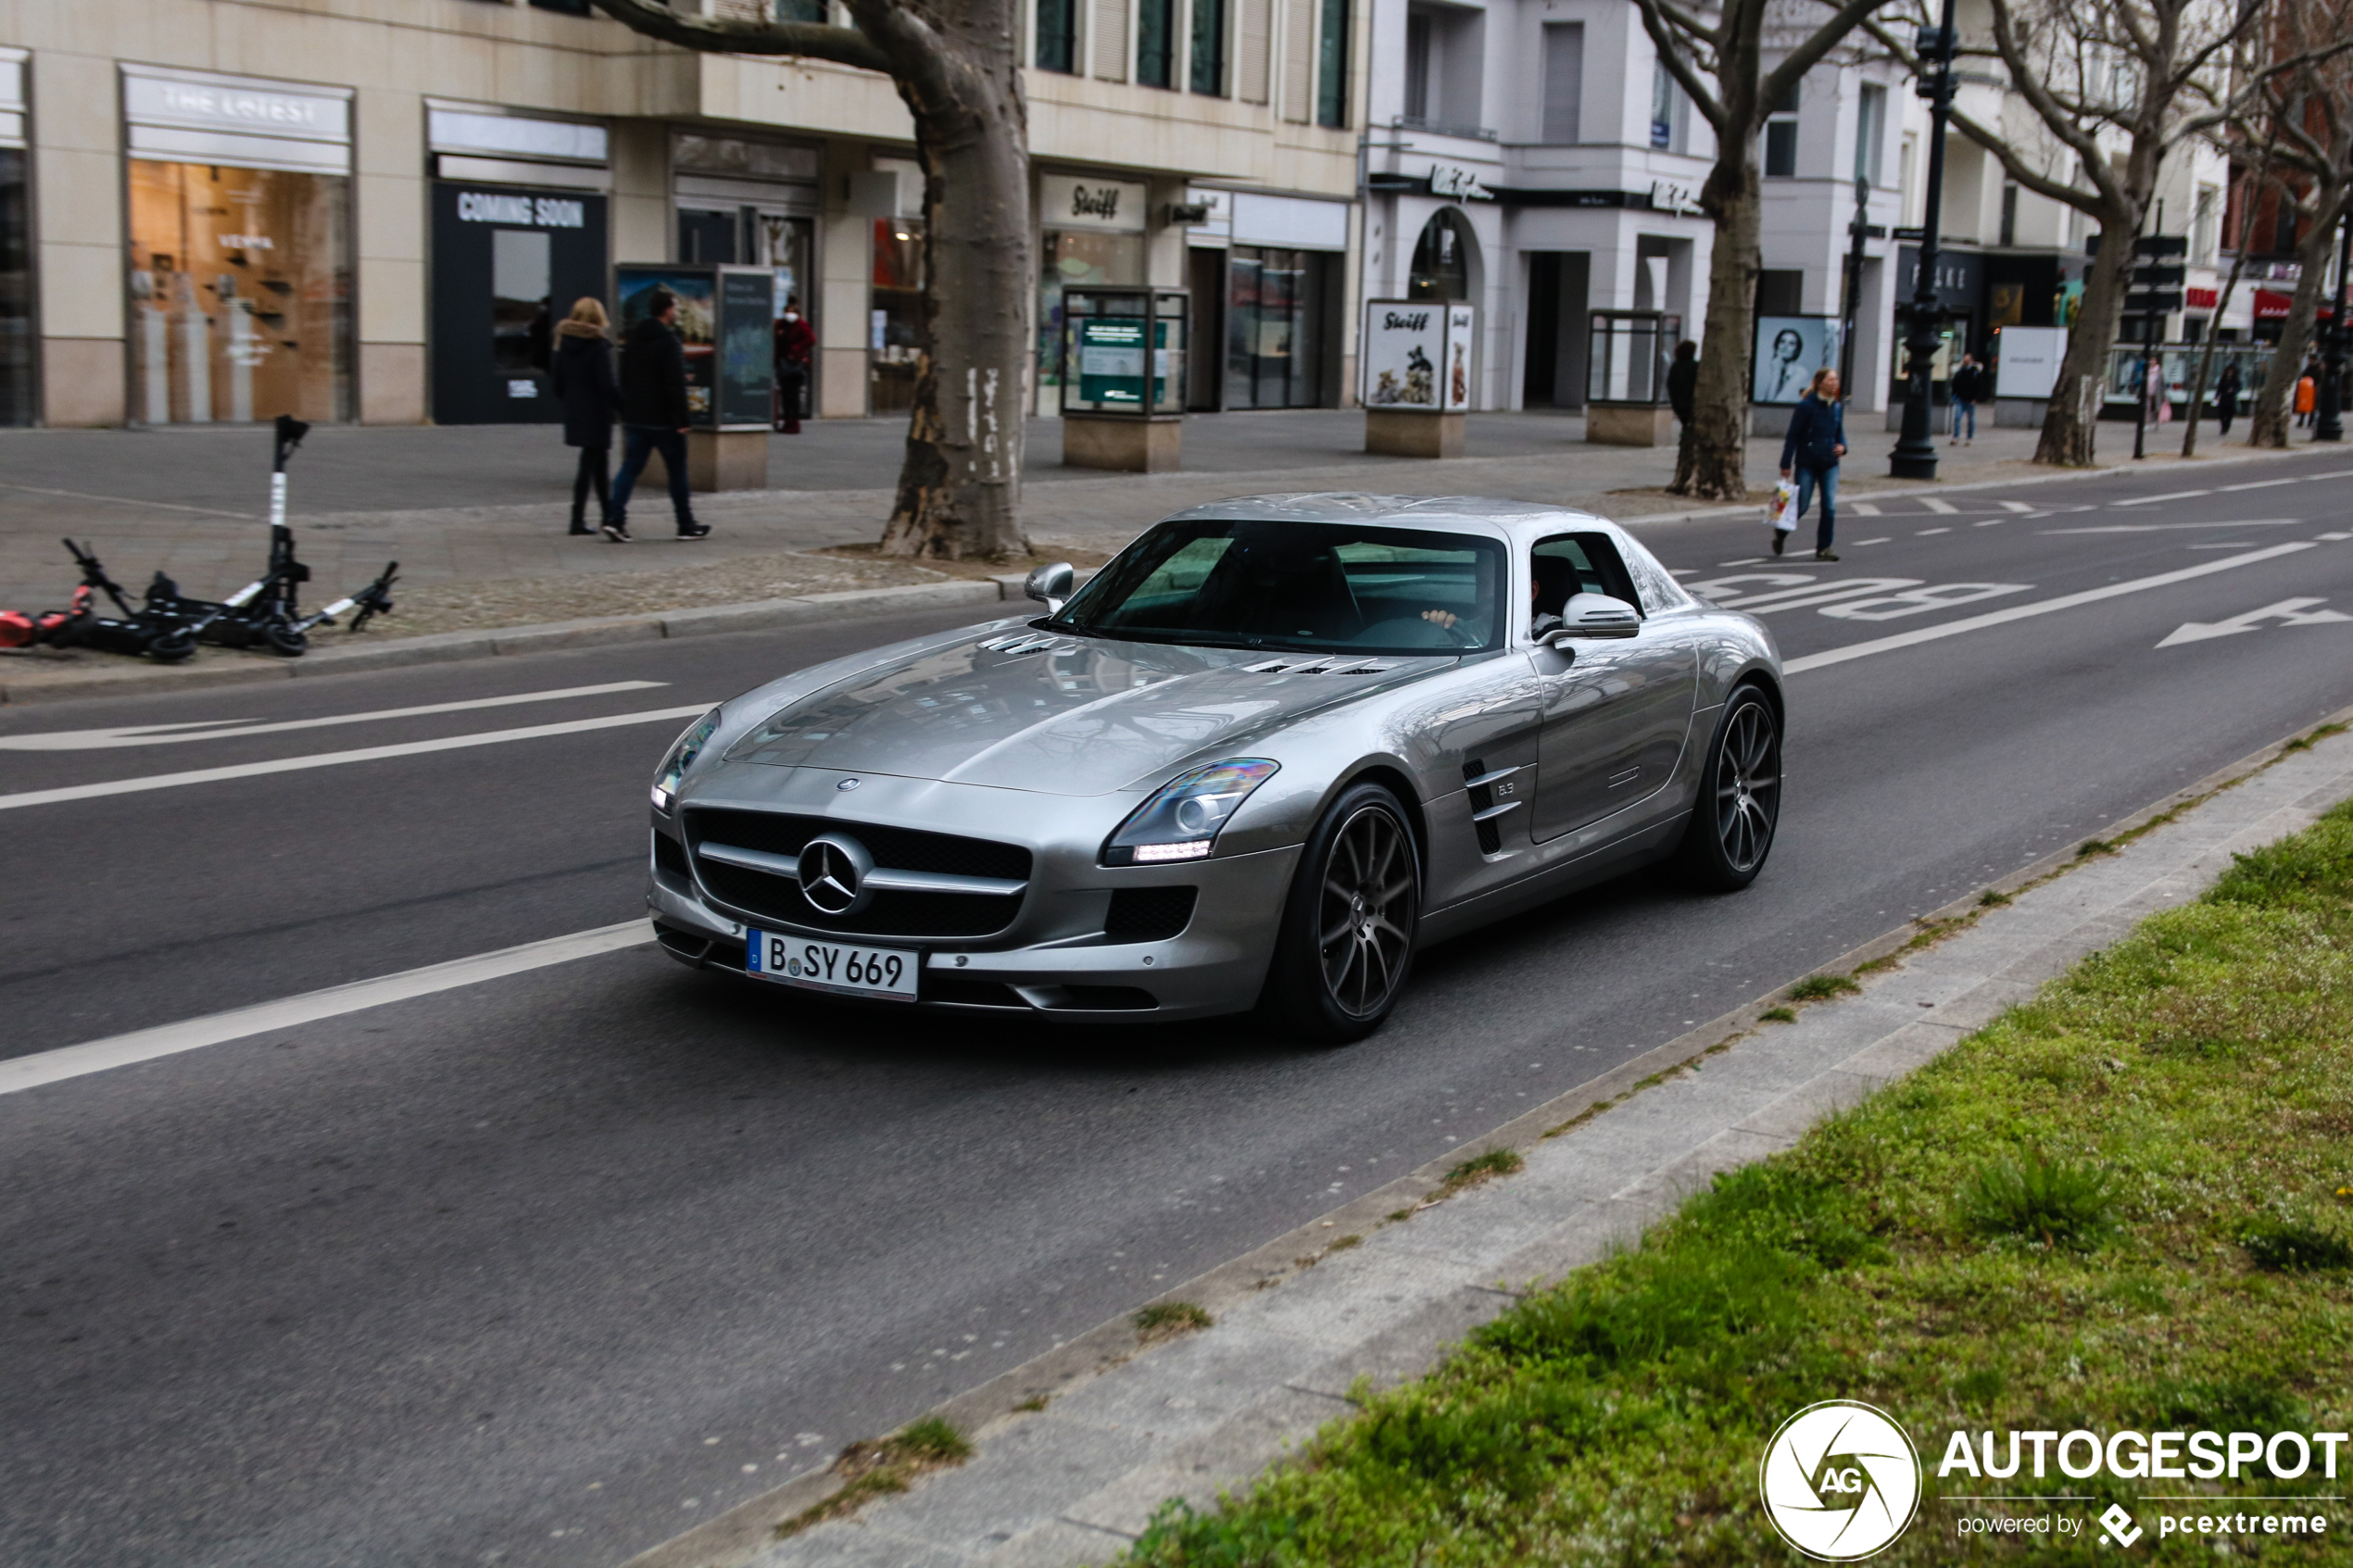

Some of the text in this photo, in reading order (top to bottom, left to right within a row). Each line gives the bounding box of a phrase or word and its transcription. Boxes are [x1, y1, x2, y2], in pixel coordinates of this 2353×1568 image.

[162, 86, 215, 113] THE
[458, 192, 585, 229] COMING SOON
[1072, 184, 1119, 220] Steiff
[1383, 311, 1430, 332] Steiff
[1498, 782, 1514, 797] 6.3
[751, 954, 758, 964] D
[771, 937, 786, 971] B
[846, 950, 903, 987] 669
